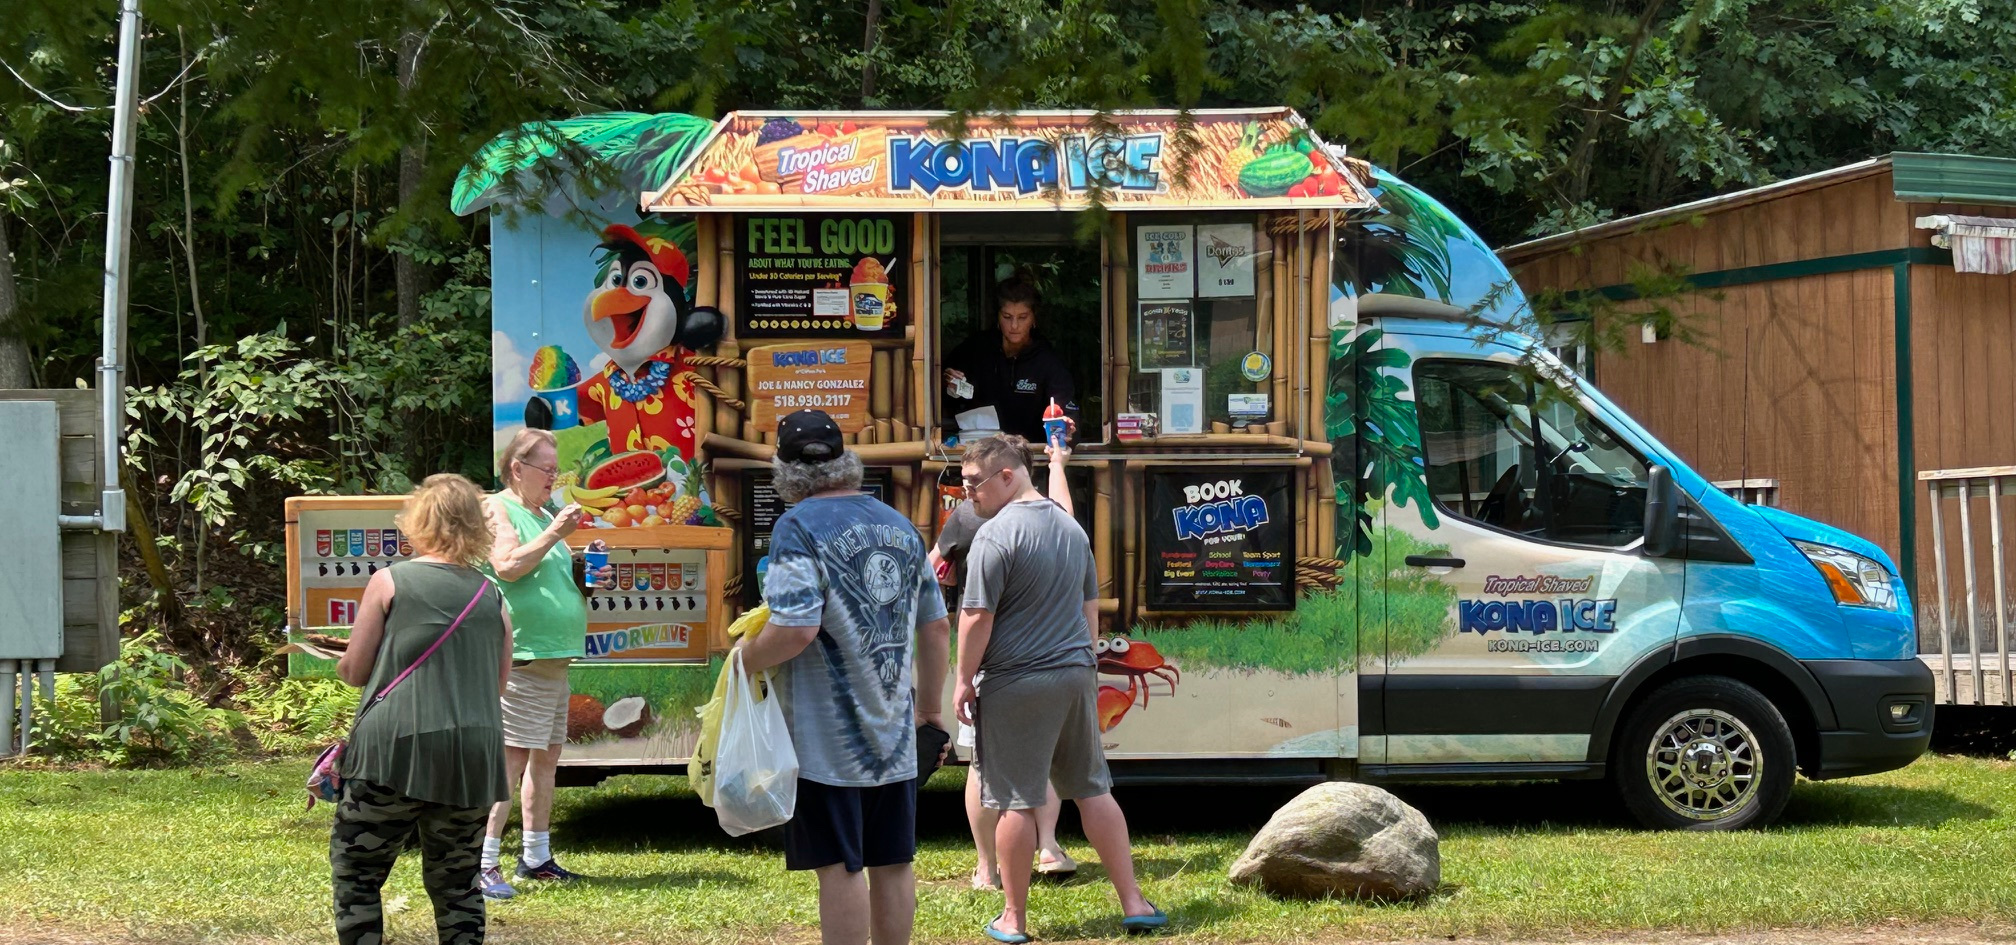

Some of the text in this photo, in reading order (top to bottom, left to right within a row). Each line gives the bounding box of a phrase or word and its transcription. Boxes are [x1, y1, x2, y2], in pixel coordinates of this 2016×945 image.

[778, 138, 858, 175] Tropical
[888, 134, 1161, 199] KONA ICE
[802, 158, 877, 195] Shaved
[748, 218, 895, 256] FEEL GOOD
[1145, 231, 1187, 241] ICE COLD
[1206, 245, 1245, 258] Doritos
[748, 258, 772, 268] ABOUT
[774, 258, 795, 268] WHAT
[798, 258, 822, 269] YOU'VE
[1145, 262, 1188, 273] DRINKS
[749, 272, 768, 280] Under
[778, 272, 804, 280] Calories
[805, 273, 816, 282] per
[772, 348, 847, 367] KONA ICE
[758, 379, 865, 390] JOE & NANCY GONZALEZ
[774, 394, 851, 407] 518.930.2117
[556, 400, 571, 416] K
[1183, 479, 1244, 504] BOOK
[1172, 495, 1269, 541] KONA
[833, 523, 870, 562] NEW
[1203, 536, 1220, 546] FOR
[1209, 551, 1232, 559] School
[1262, 551, 1281, 560] Sport
[1164, 570, 1175, 579] Big
[1252, 570, 1272, 579] Party
[1485, 575, 1593, 597] Tropical Shaved
[1459, 599, 1618, 636] KONA ICE
[585, 624, 689, 657] AVORWAVE
[1488, 639, 1599, 653] KONA-ICE.COM
